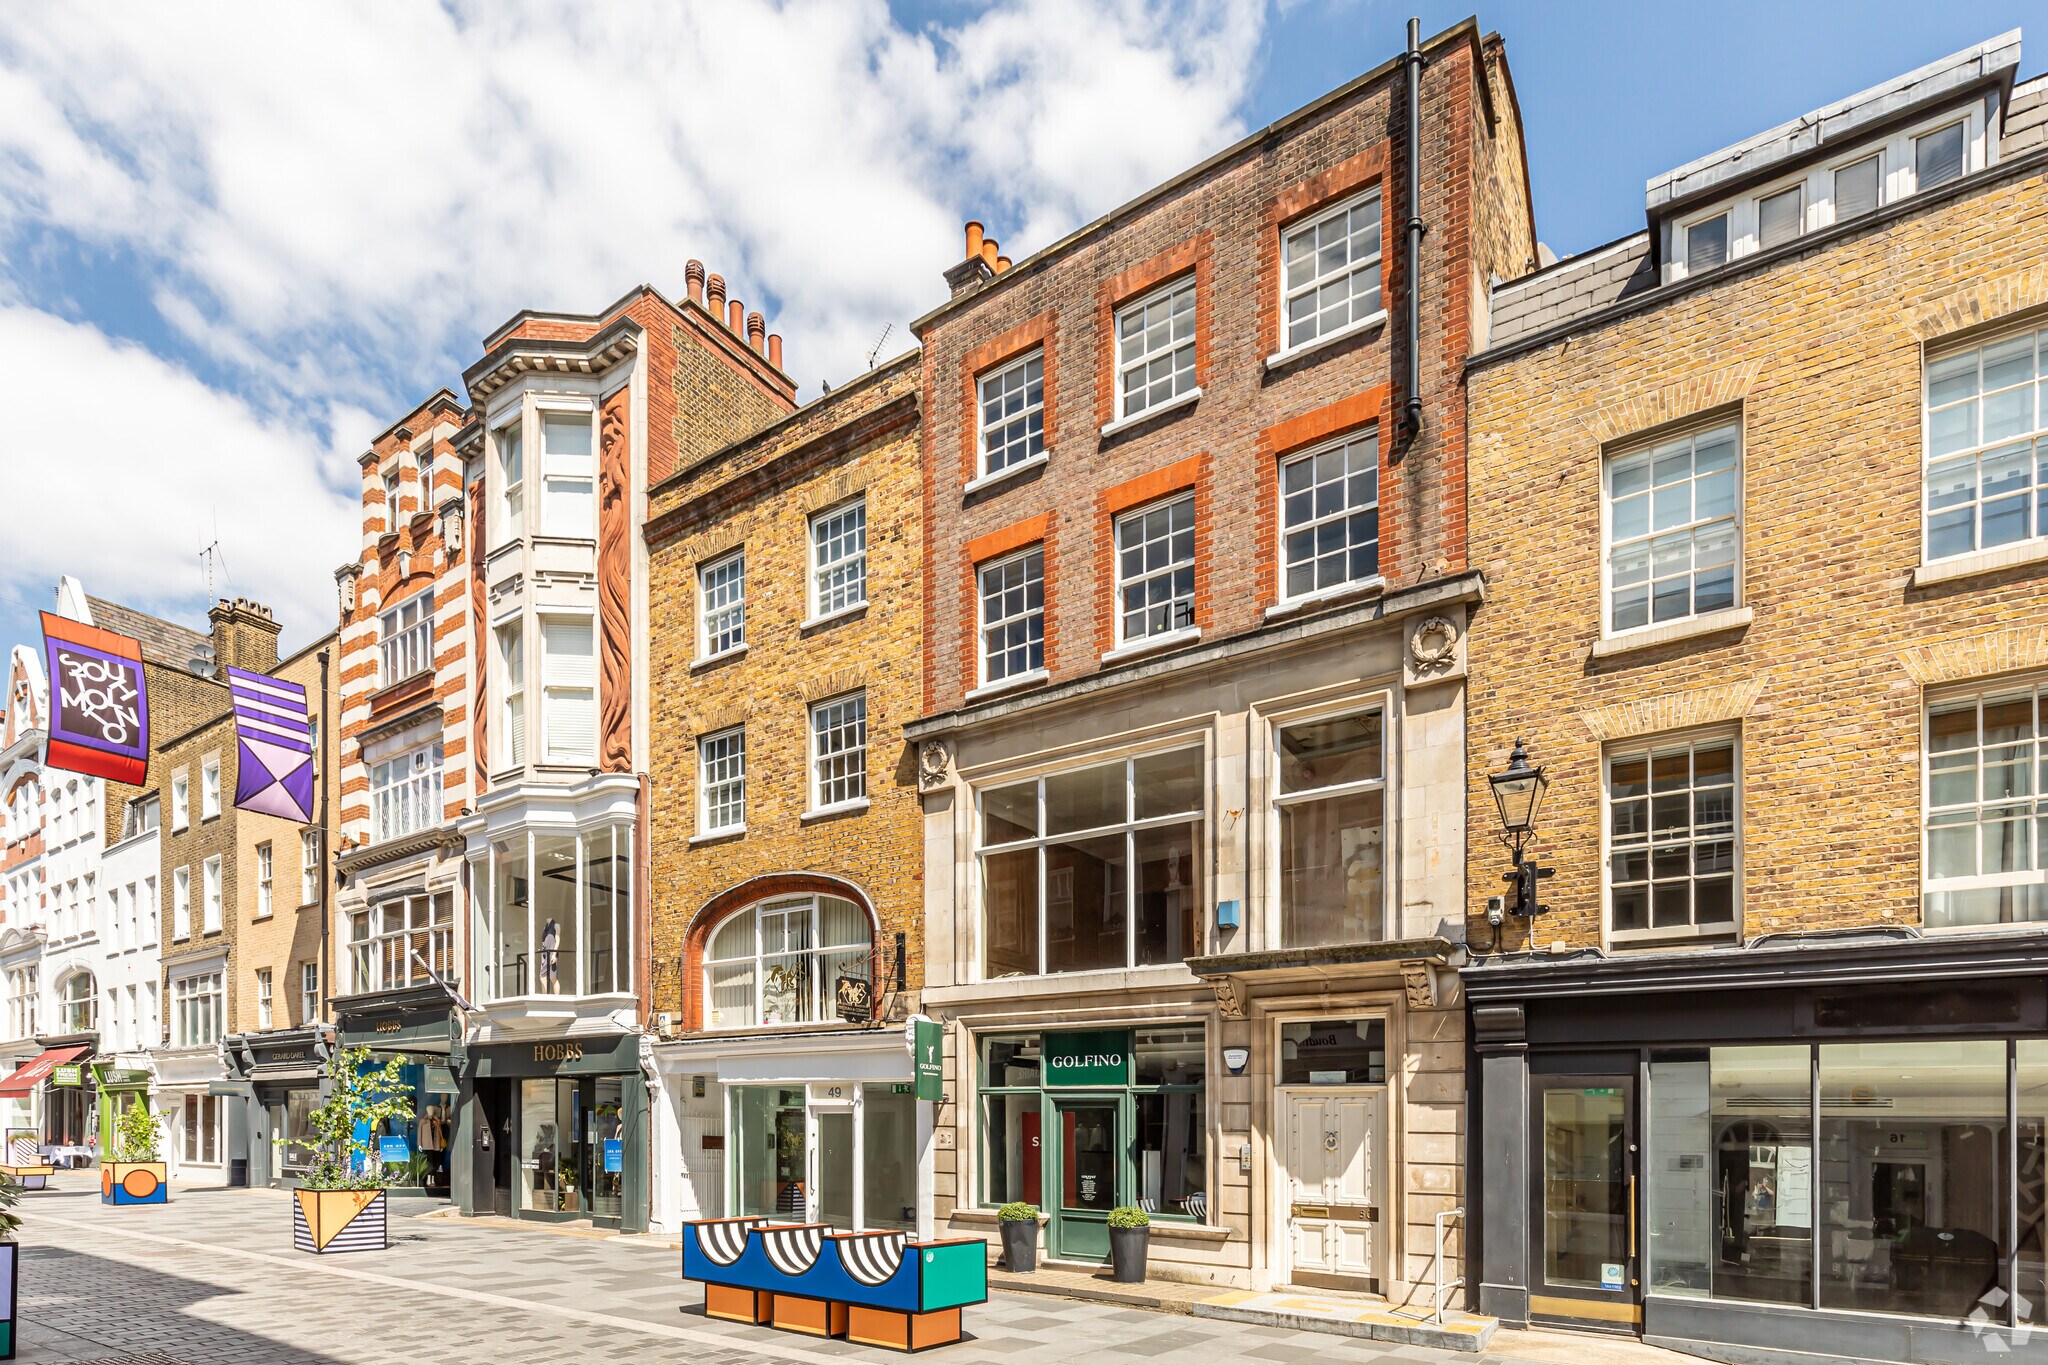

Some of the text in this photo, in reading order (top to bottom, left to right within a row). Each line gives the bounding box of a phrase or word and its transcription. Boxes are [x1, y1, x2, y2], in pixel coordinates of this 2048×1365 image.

[533, 1042, 584, 1062] HOBBS
[919, 1063, 942, 1071] GOLFINO
[1052, 1053, 1122, 1069] GOLFINO
[104, 1070, 122, 1083] LUSH
[828, 1086, 841, 1098] 49
[503, 1118, 512, 1134] 4
